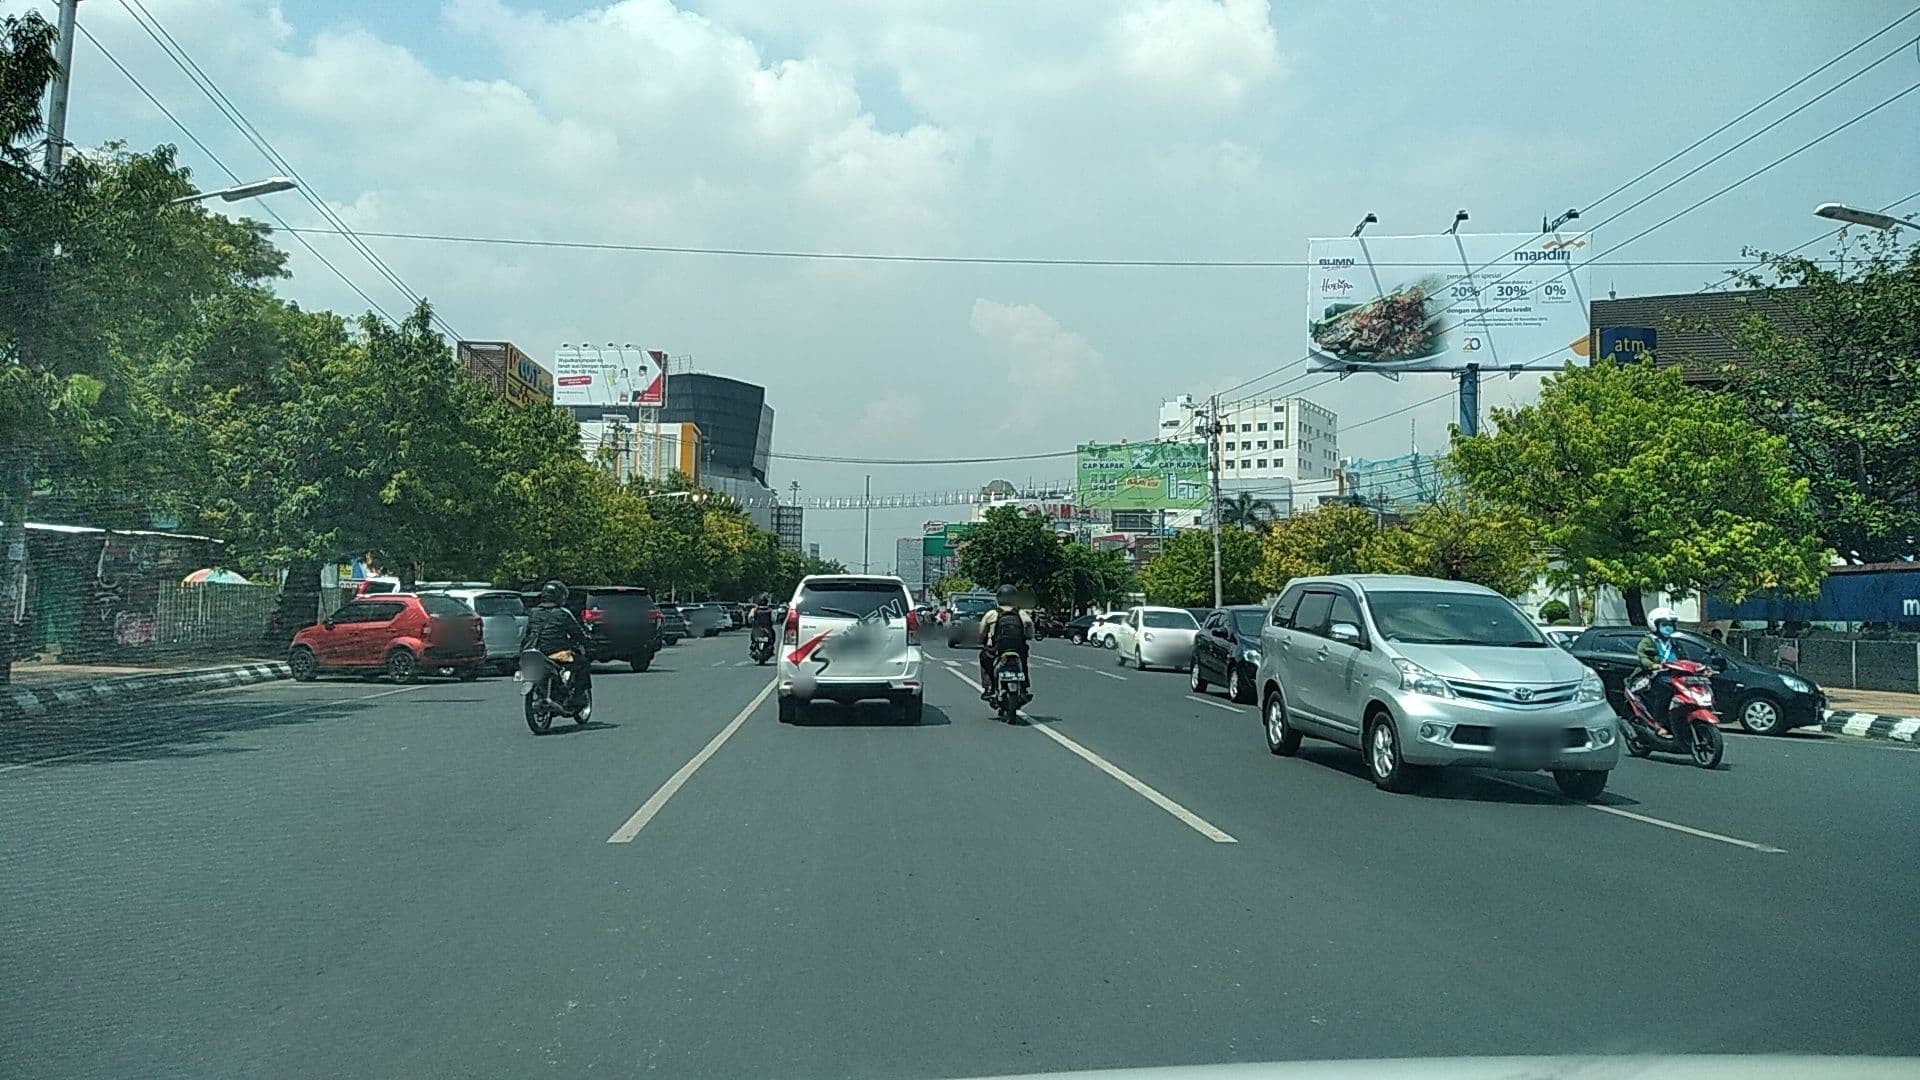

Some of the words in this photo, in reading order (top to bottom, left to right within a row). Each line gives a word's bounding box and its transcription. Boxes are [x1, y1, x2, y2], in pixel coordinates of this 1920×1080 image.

[1514, 248, 1571, 261] mandiri
[1544, 285, 1567, 296] 0%
[1614, 337, 1645, 352] atm
